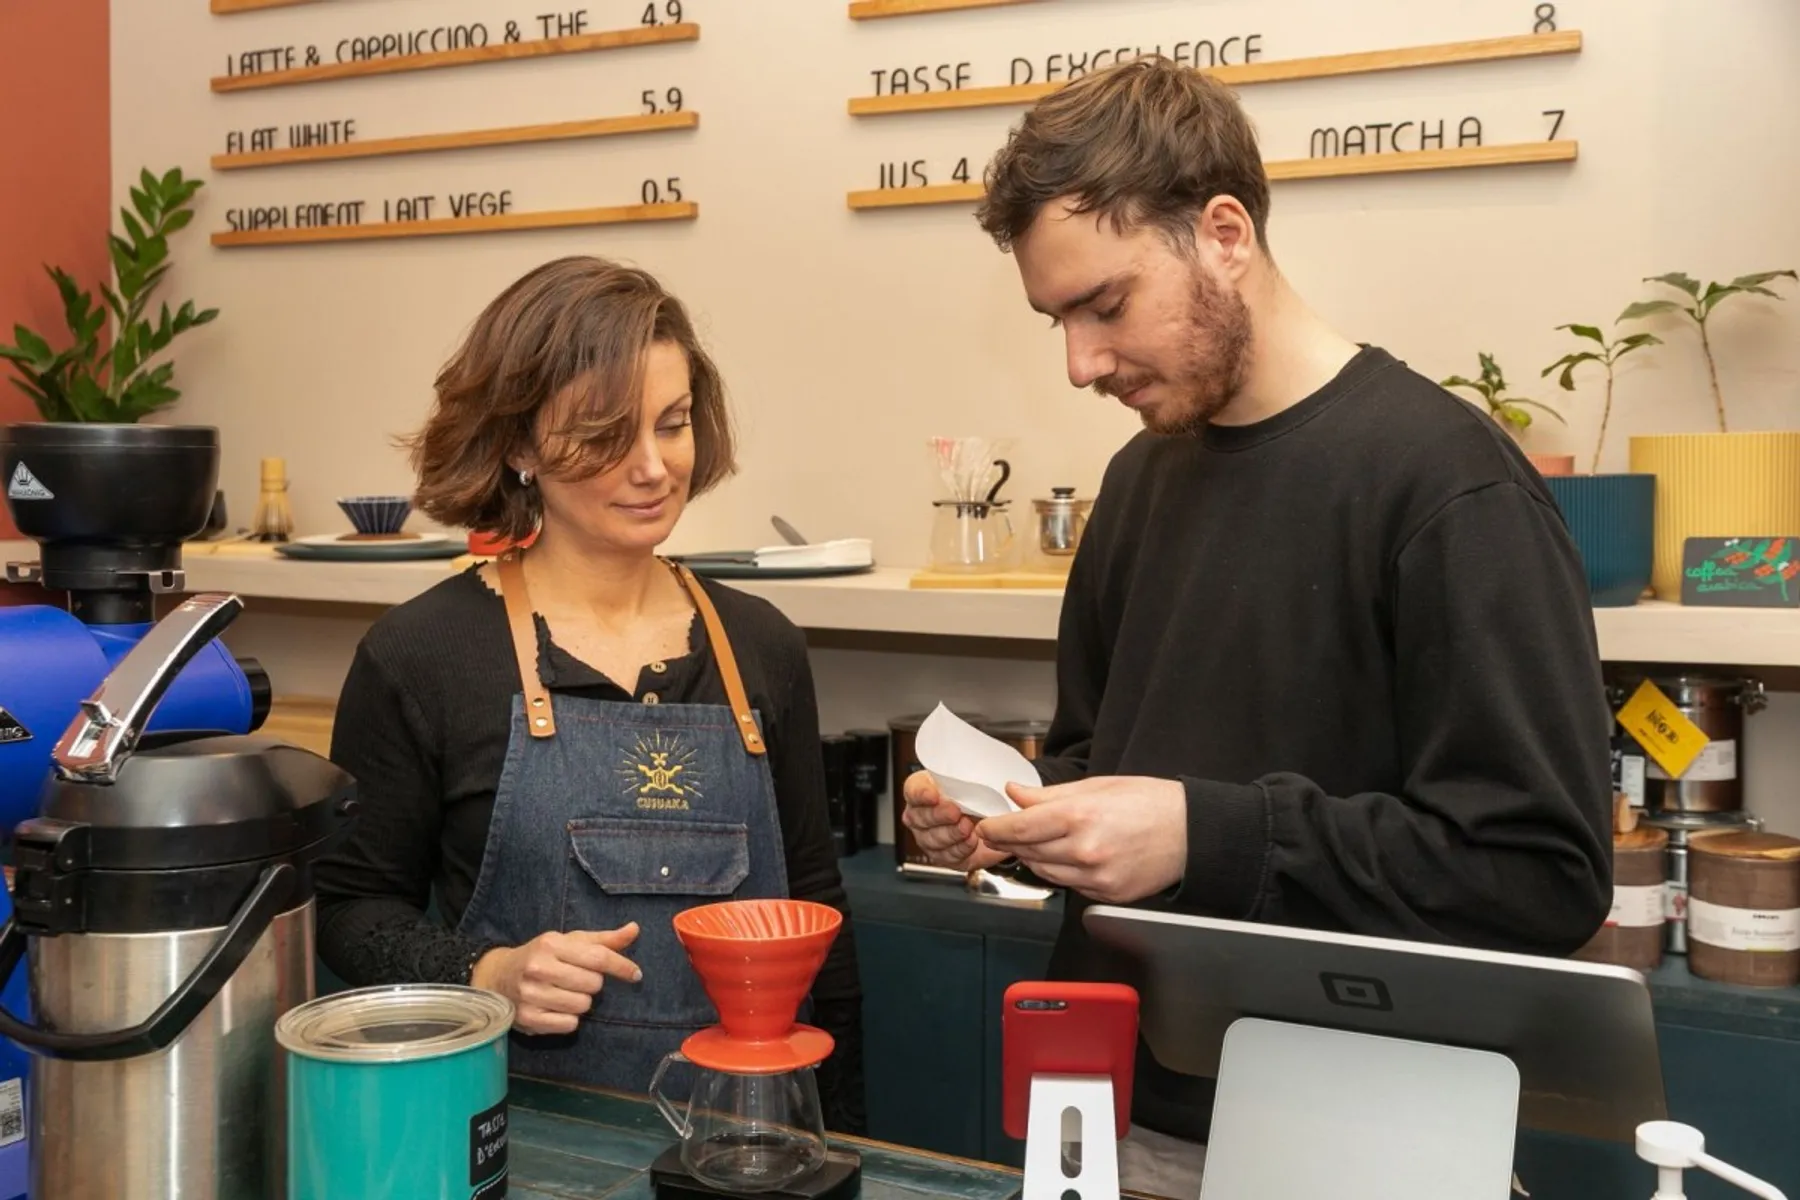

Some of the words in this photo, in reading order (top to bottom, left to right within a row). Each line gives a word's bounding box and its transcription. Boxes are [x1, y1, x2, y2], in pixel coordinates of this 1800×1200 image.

[304, 45, 321, 67] &
[336, 23, 488, 63] CAPPUCCINO
[503, 20, 521, 43] &
[641, 0, 683, 26] 4.9
[870, 61, 972, 97] TASSE
[1533, 3, 1557, 34] 8
[641, 87, 684, 115] 5.9
[950, 157, 972, 184] 4
[1541, 110, 1566, 141] 7
[641, 176, 683, 204] 0.5
